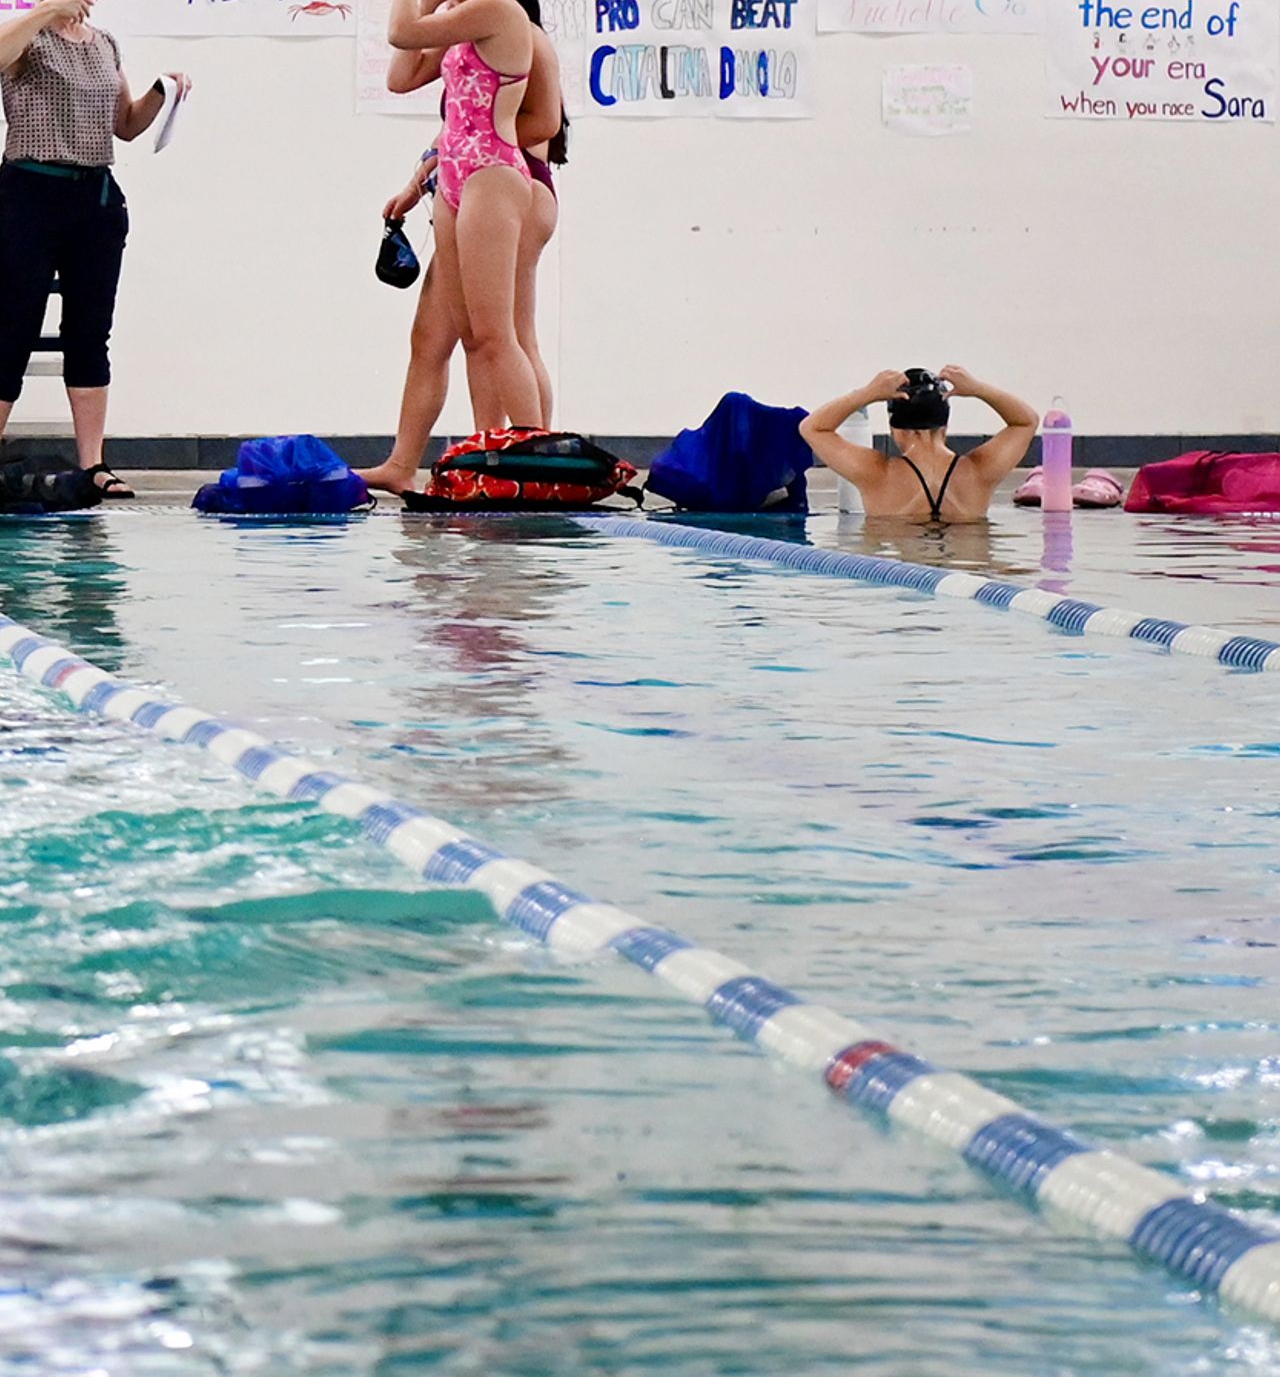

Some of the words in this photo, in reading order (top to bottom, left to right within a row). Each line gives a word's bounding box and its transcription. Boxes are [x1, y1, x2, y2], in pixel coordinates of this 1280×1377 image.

[1206, 1, 1240, 37] of
[1091, 55, 1155, 86] your
[1167, 60, 1206, 80] era
[1060, 90, 1116, 116] when
[1125, 101, 1157, 119] you
[1162, 101, 1195, 116] race
[1201, 77, 1265, 119] Sara
